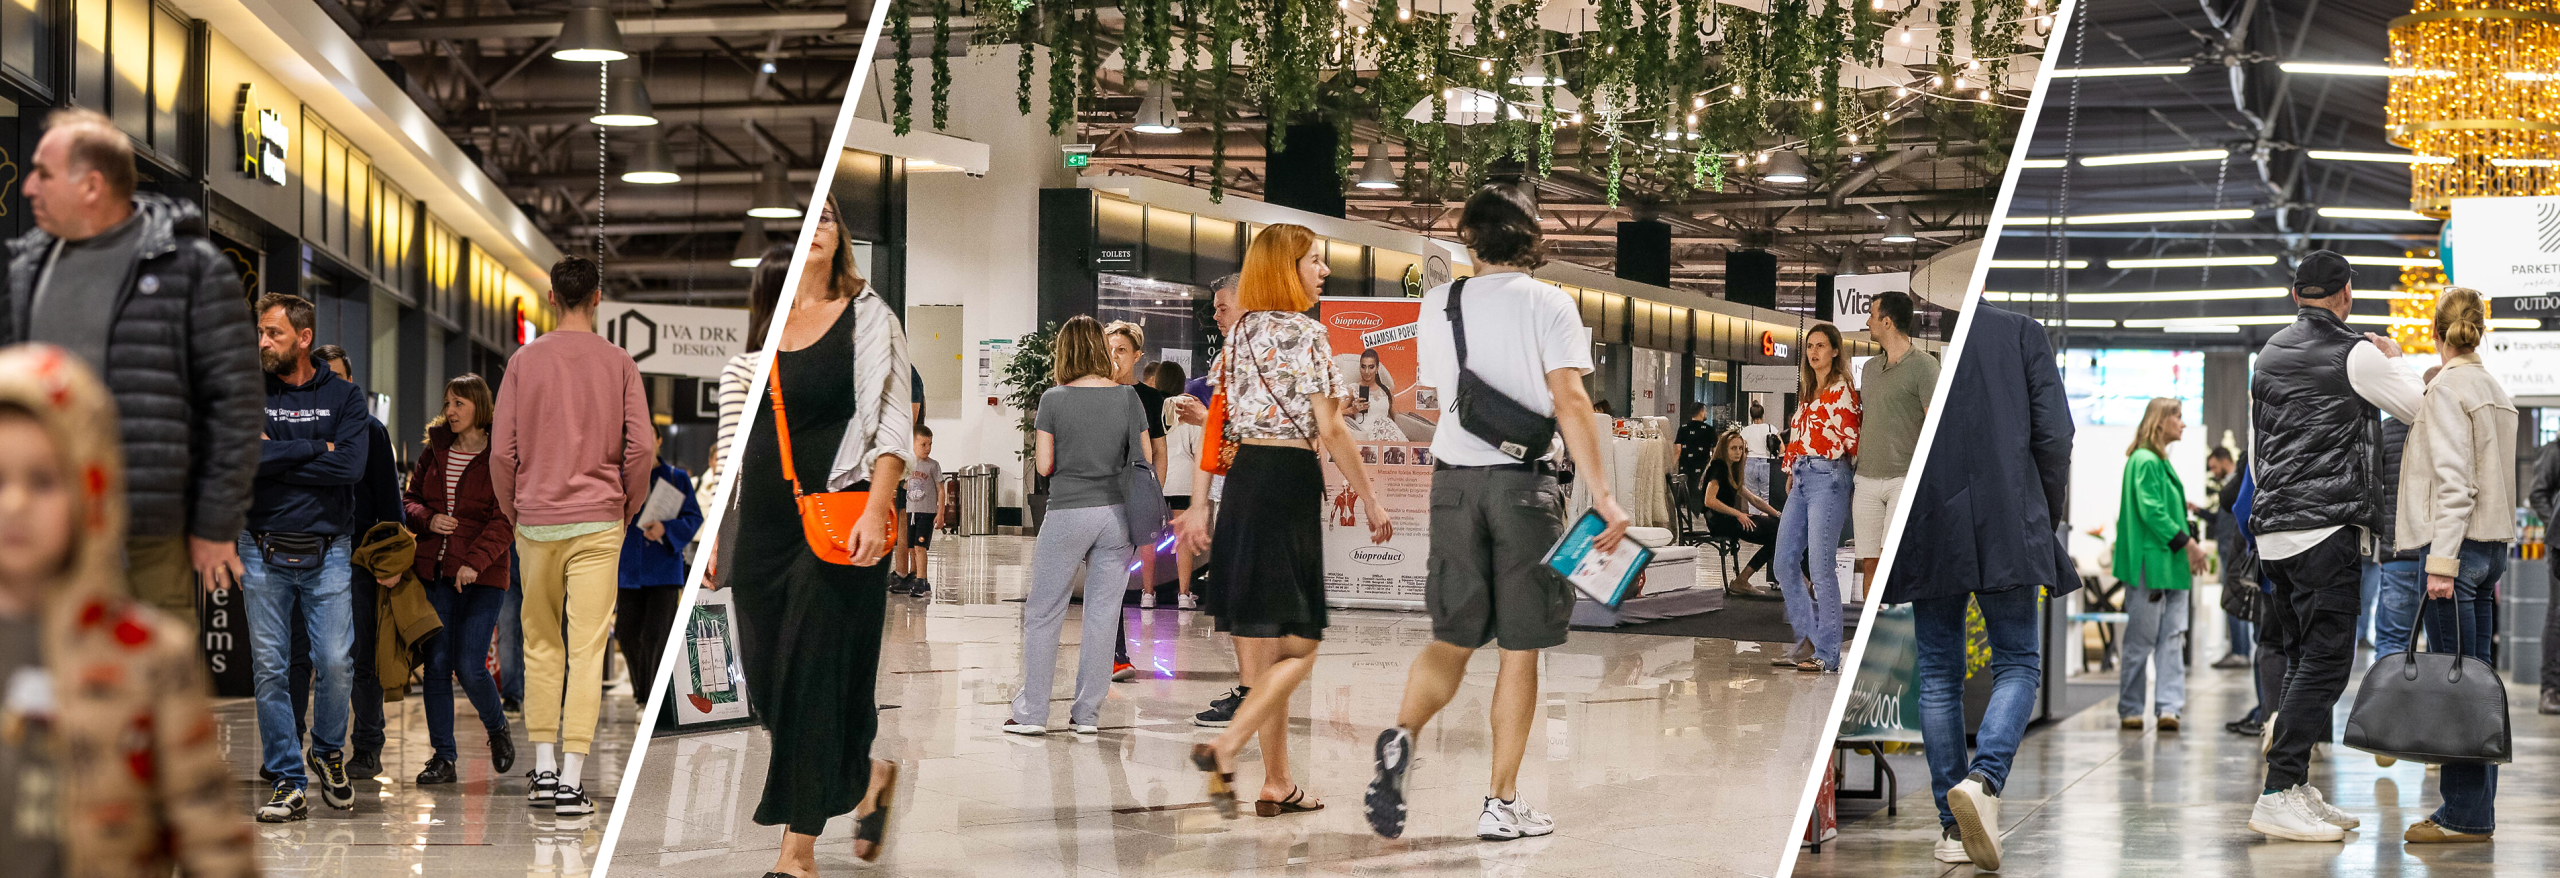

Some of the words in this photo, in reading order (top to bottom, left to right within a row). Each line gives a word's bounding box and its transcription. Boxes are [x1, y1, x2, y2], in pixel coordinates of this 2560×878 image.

[1101, 250, 1131, 258] TOILETS
[2511, 263, 2560, 275] PARKET
[2514, 296, 2560, 312] OUTDO
[1334, 316, 1381, 327] bioproduct
[662, 323, 692, 341] IVA
[699, 325, 738, 343] DRK
[1364, 330, 1397, 348] SAJAMSKI
[1398, 323, 1419, 340] POPUS
[672, 342, 727, 357] DESIGN
[1353, 550, 1402, 562] bioproduct
[206, 587, 233, 673] eams
